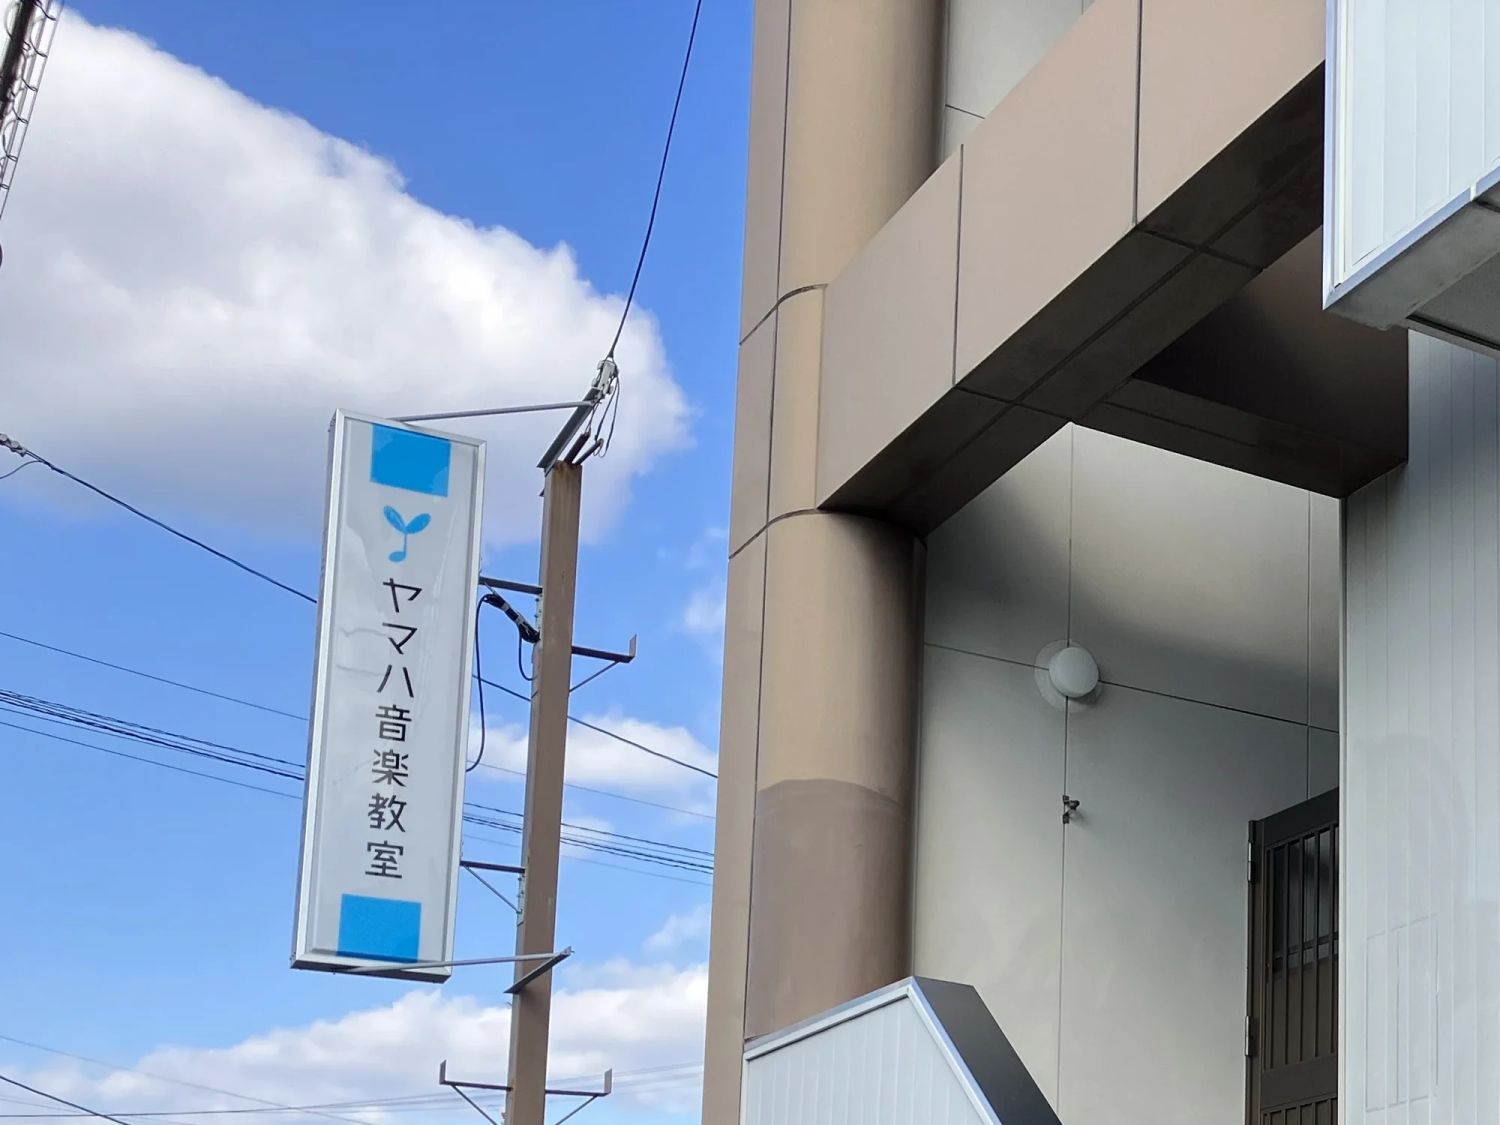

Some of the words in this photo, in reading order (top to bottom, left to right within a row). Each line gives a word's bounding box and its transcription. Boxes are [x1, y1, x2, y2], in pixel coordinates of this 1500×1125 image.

[365, 577, 422, 879] ヤマハ音楽教室
